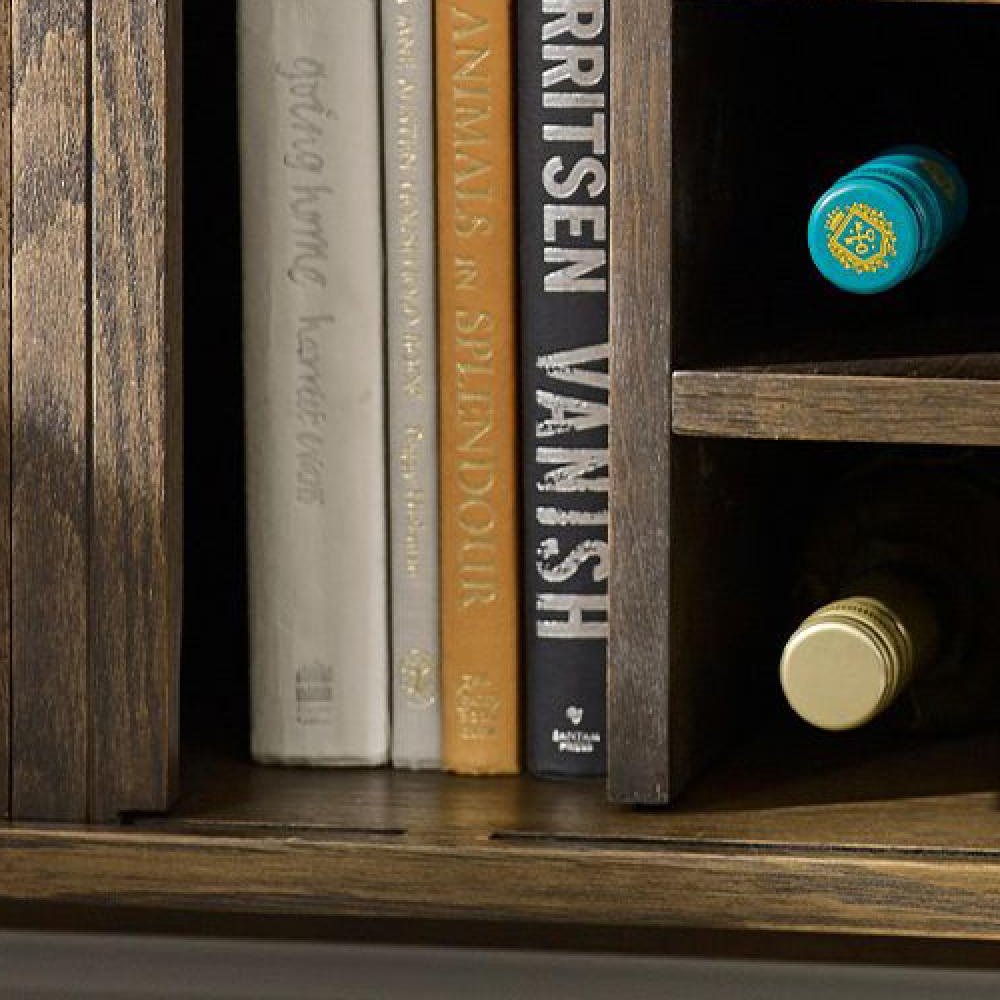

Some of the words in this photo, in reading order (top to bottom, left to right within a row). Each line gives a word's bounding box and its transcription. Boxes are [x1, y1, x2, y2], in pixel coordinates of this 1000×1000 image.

[273, 55, 340, 176] going
[452, 6, 492, 239] ANIMALS
[287, 185, 334, 289] home
[455, 310, 497, 609] SPLENDOUR
[535, 342, 610, 639] VANISH
